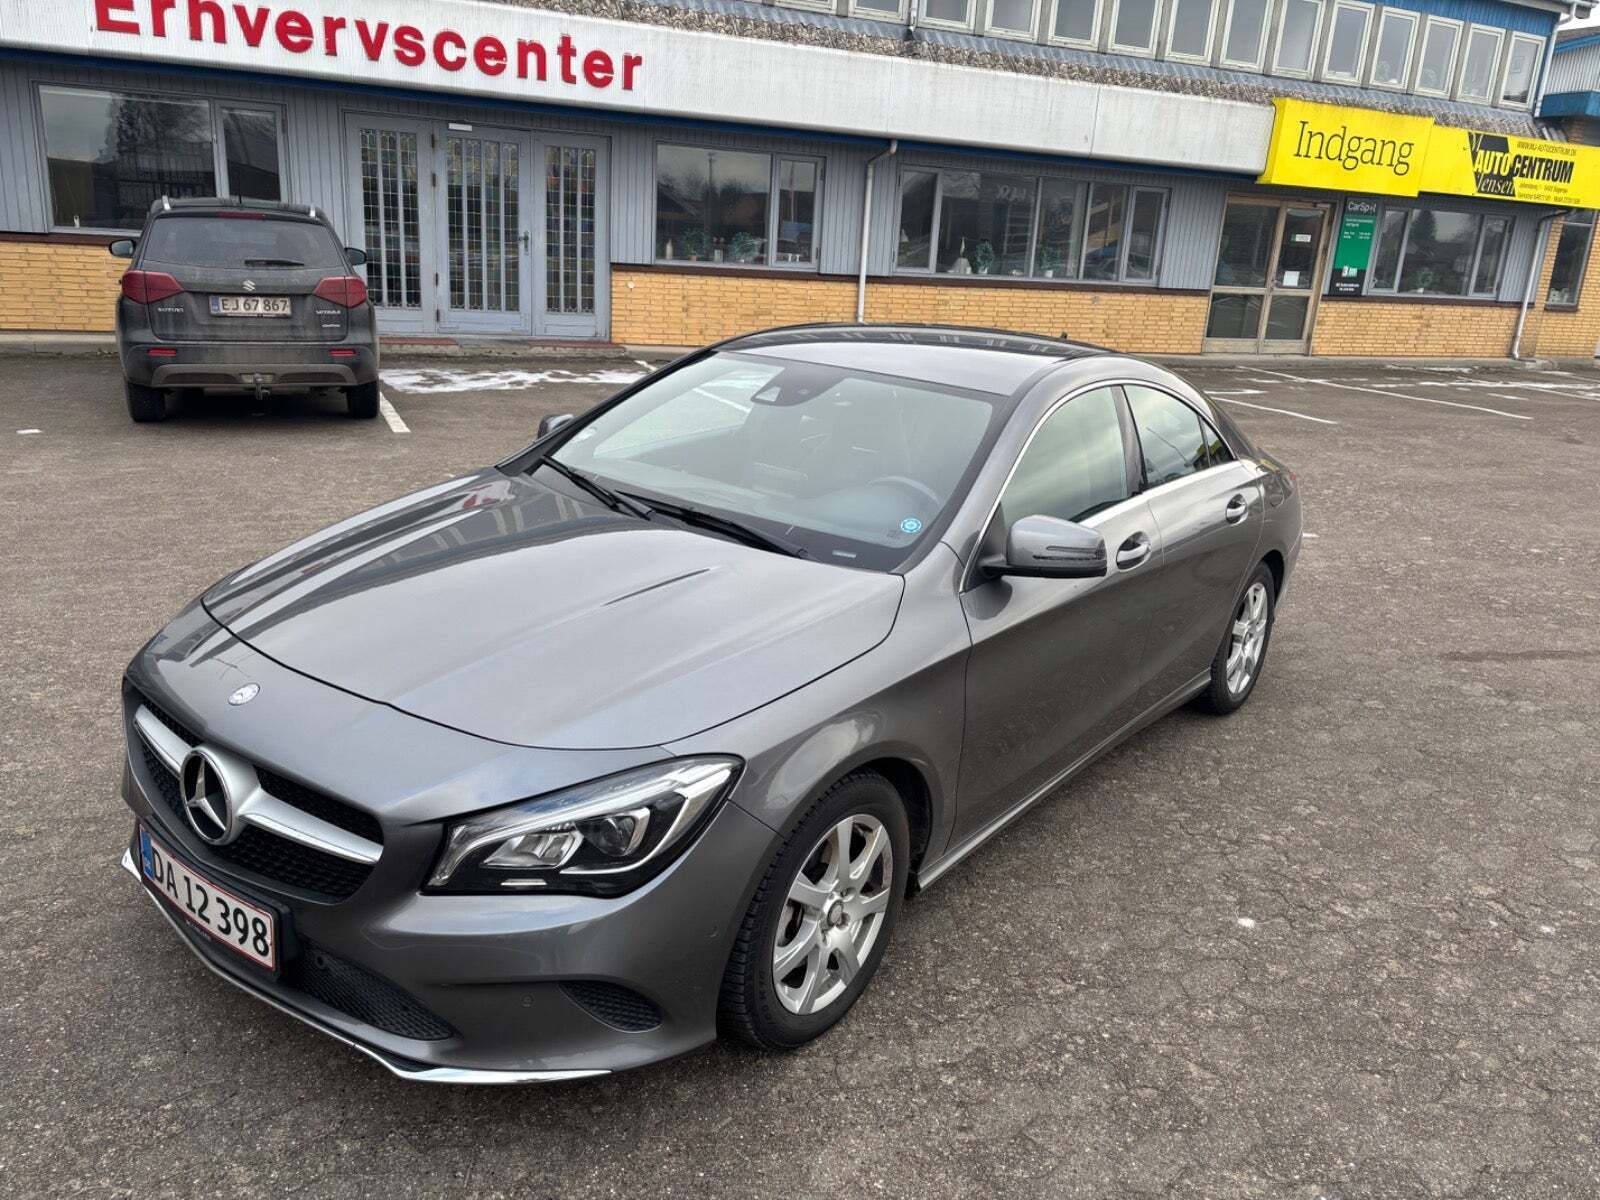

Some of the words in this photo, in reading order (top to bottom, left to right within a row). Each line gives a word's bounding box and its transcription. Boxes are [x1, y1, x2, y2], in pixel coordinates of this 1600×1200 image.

[94, 0, 643, 91] Erhvervscenter
[1293, 121, 1415, 176] Indgang
[1474, 149, 1511, 177] AUTO
[1512, 154, 1575, 184] CENTRUM
[221, 298, 240, 311] EJ
[243, 298, 260, 311] 67
[262, 299, 288, 312] 867
[152, 847, 179, 900] DA
[184, 875, 210, 925] 12
[215, 896, 270, 958] 398
